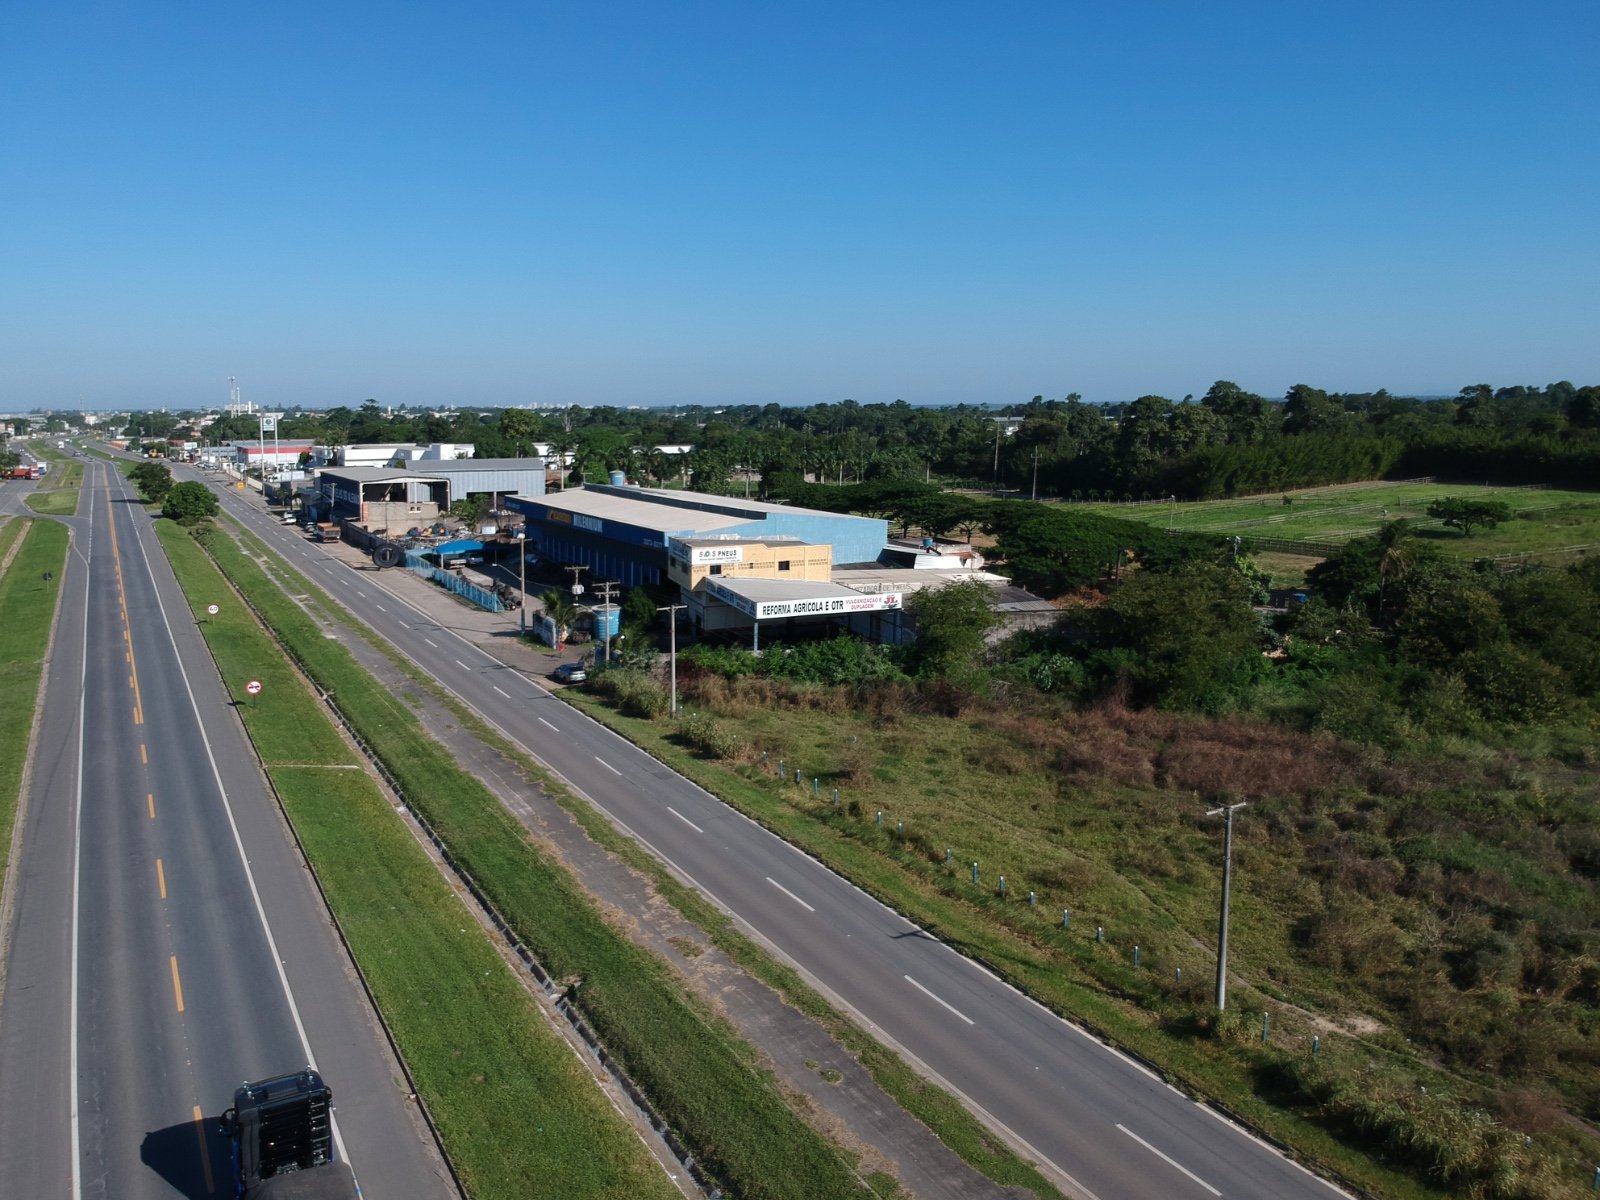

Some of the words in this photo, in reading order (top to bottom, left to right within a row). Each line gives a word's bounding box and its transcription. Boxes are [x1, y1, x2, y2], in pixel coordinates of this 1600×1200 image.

[762, 604, 791, 616] REFORMA
[793, 600, 823, 613] AGRÍCOLA
[825, 601, 829, 611] E
[831, 600, 844, 611] OTR
